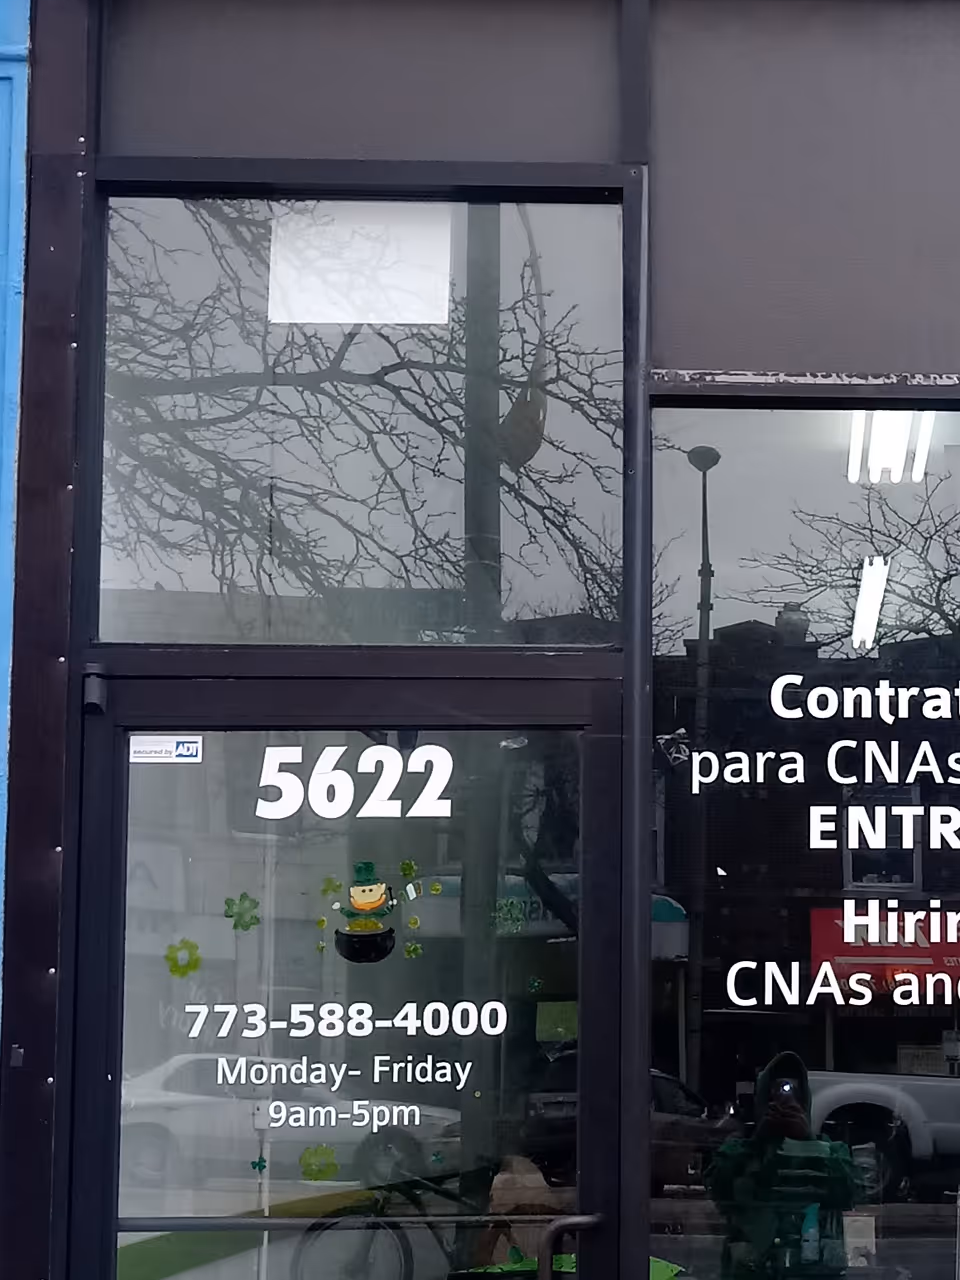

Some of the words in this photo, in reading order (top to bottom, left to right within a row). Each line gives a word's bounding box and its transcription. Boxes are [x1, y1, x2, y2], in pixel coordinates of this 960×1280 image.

[175, 743, 198, 756] ADT
[254, 744, 454, 821] 5622
[690, 751, 805, 794] para
[725, 960, 872, 1007] CNAs
[184, 1000, 508, 1039] 773-588-4000
[216, 1054, 361, 1092] Monday-
[372, 1053, 473, 1091] Friday
[267, 1099, 421, 1134] 9am-5pm
